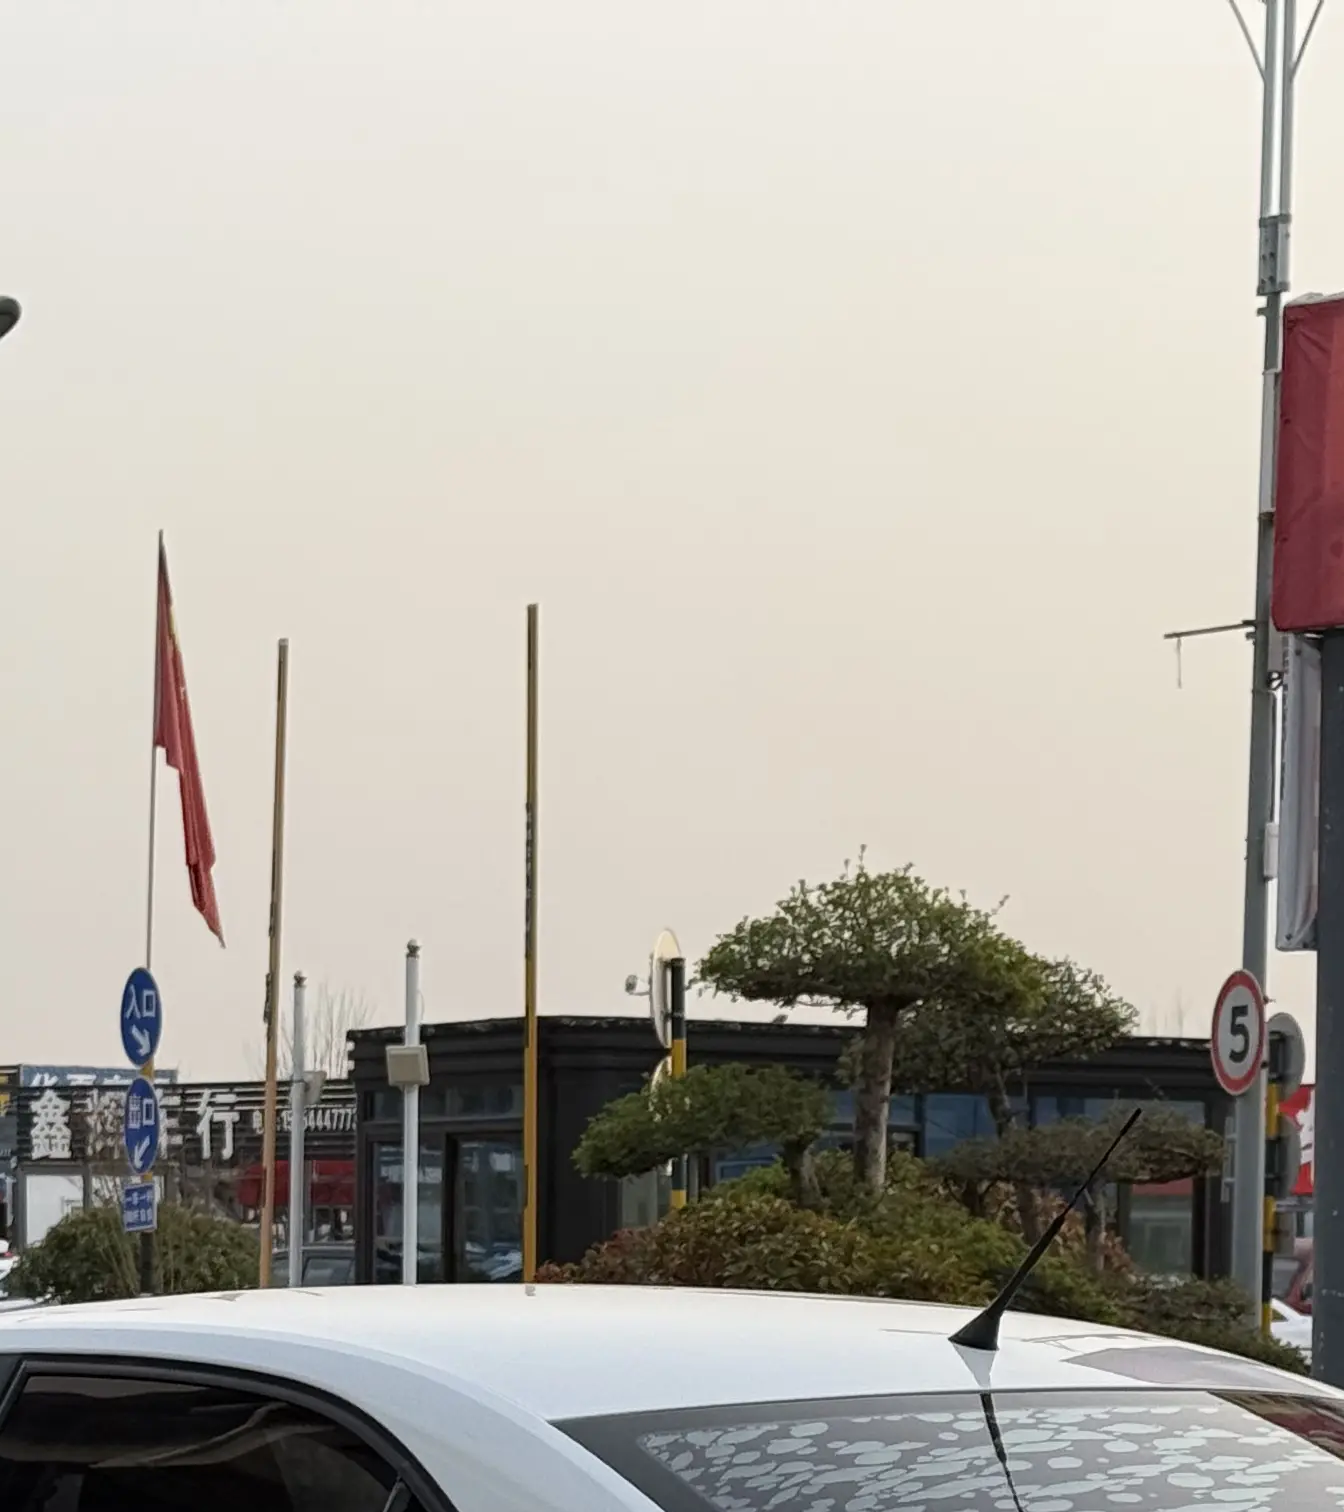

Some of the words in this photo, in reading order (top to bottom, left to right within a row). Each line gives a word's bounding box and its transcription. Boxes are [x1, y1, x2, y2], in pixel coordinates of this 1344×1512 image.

[125, 985, 156, 1019] 入口
[1229, 1005, 1250, 1063] 5
[128, 1094, 155, 1129] 出口
